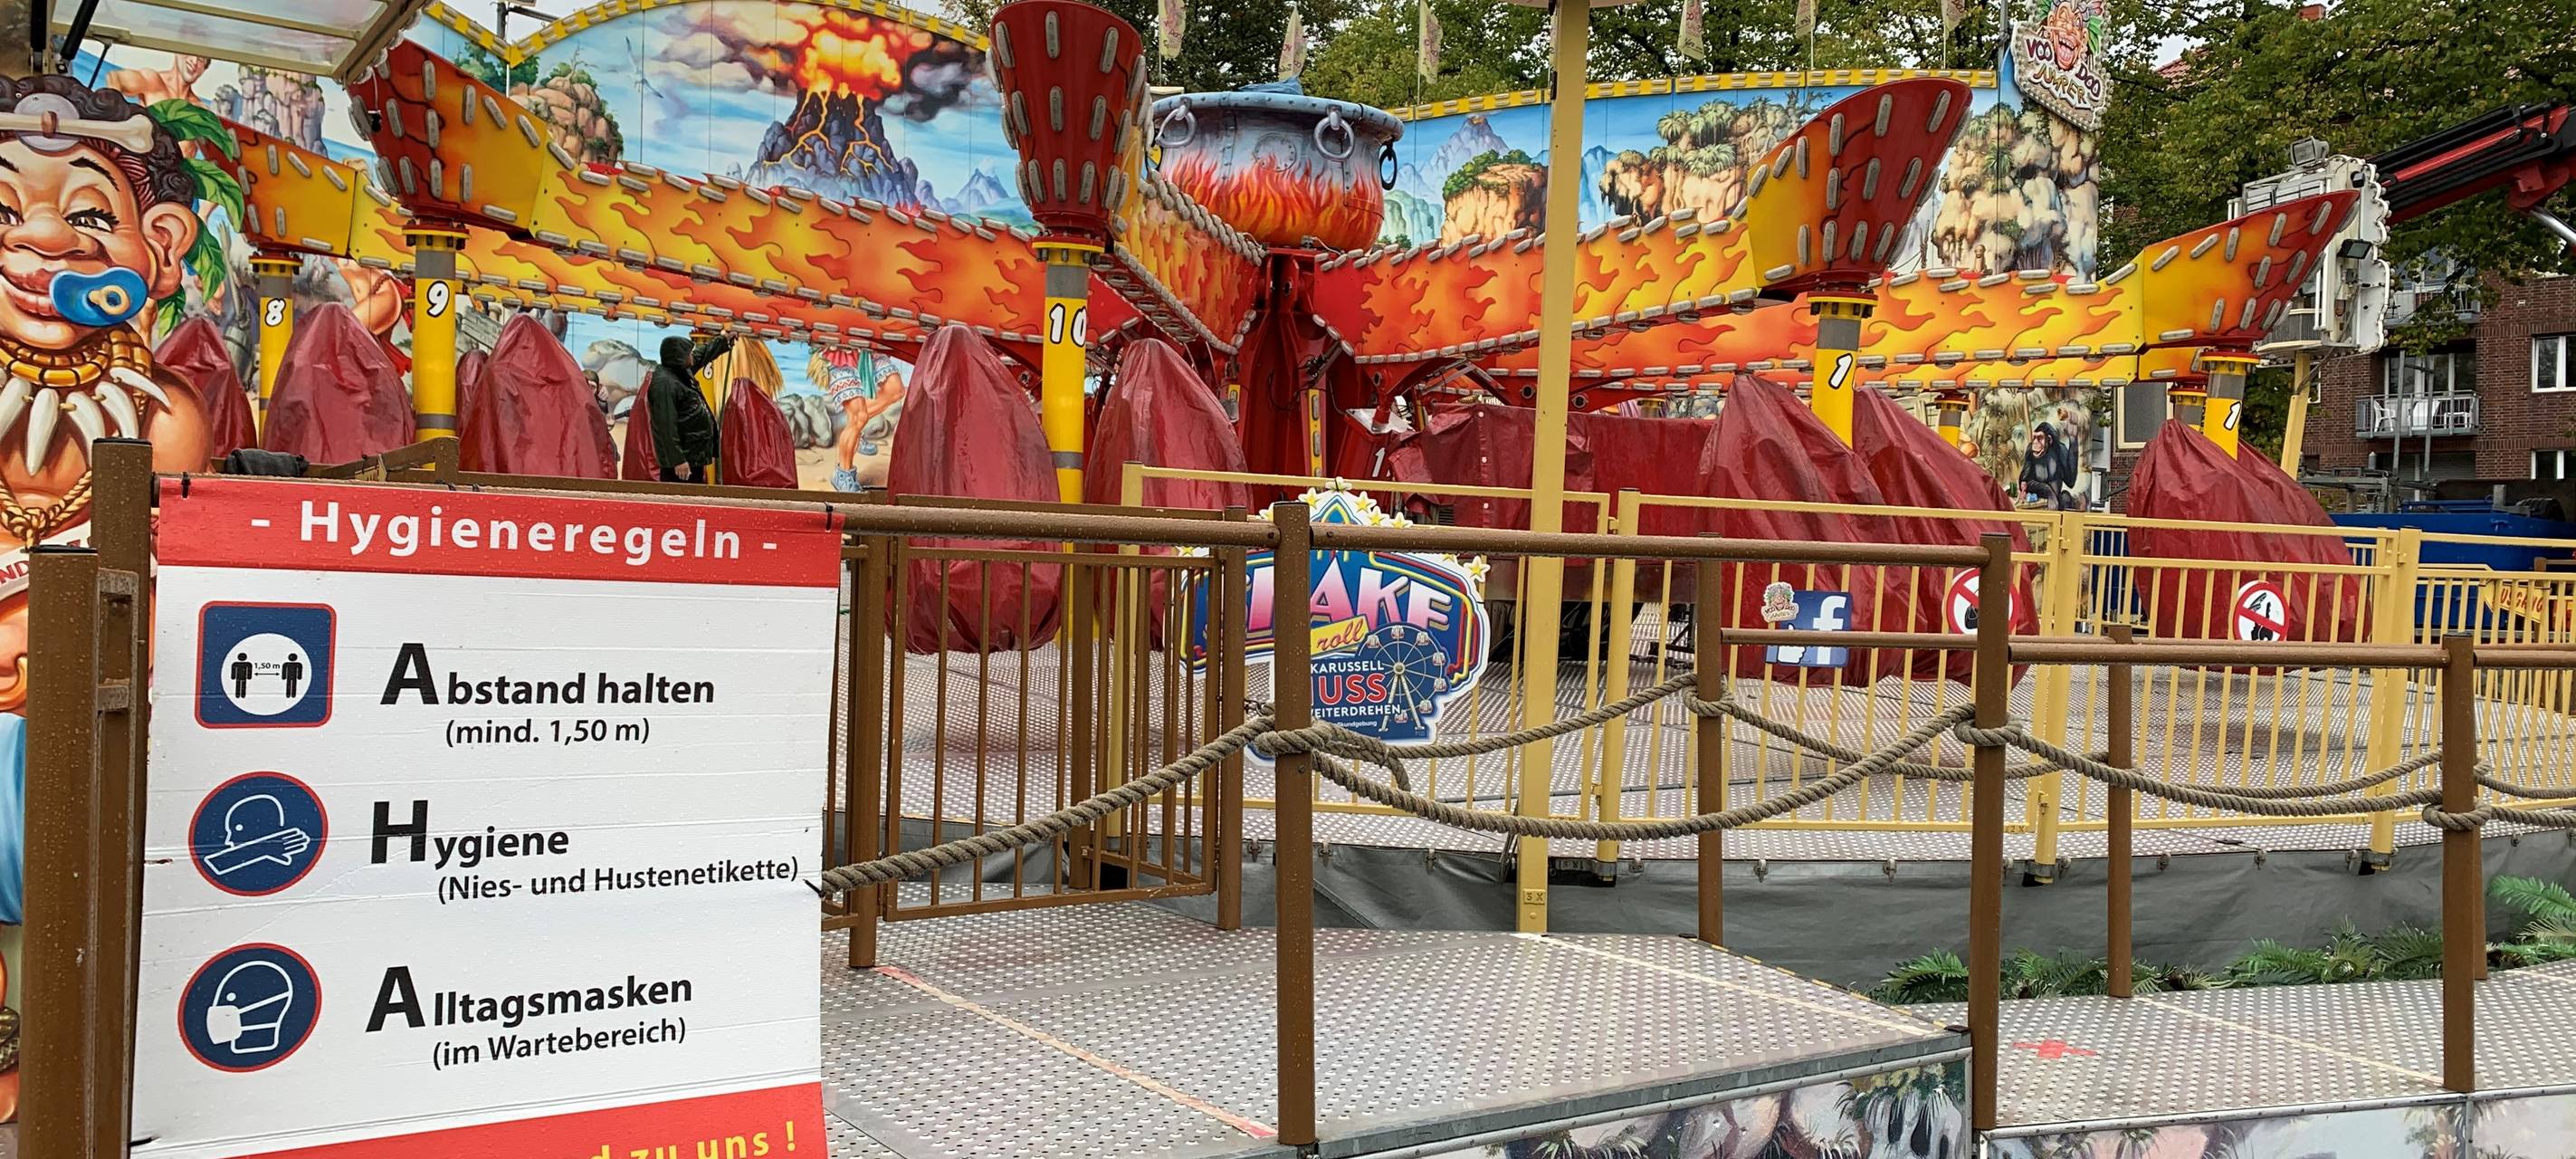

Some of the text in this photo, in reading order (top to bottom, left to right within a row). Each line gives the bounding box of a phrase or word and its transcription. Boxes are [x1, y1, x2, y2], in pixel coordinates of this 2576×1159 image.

[2026, 38, 2101, 98] VOO DOO
[2032, 64, 2087, 105] JUMPER
[265, 298, 286, 326] 8
[426, 281, 450, 317] 9
[1049, 303, 1087, 348] 10
[703, 361, 713, 379] 6
[1828, 353, 1853, 389] 1
[2223, 401, 2241, 431] 1
[301, 500, 739, 565] Hygieneregeln
[1317, 618, 1365, 651] roll
[254, 662, 272, 670] 1,50
[596, 672, 715, 704] halten
[1311, 673, 1388, 706] USS
[446, 717, 651, 748] (mind. 1,50 m)
[438, 856, 799, 905] (Nies- und Hustenetikette)
[433, 1017, 686, 1071] (im Wartebereich)
[697, 1132, 769, 1159] uns
